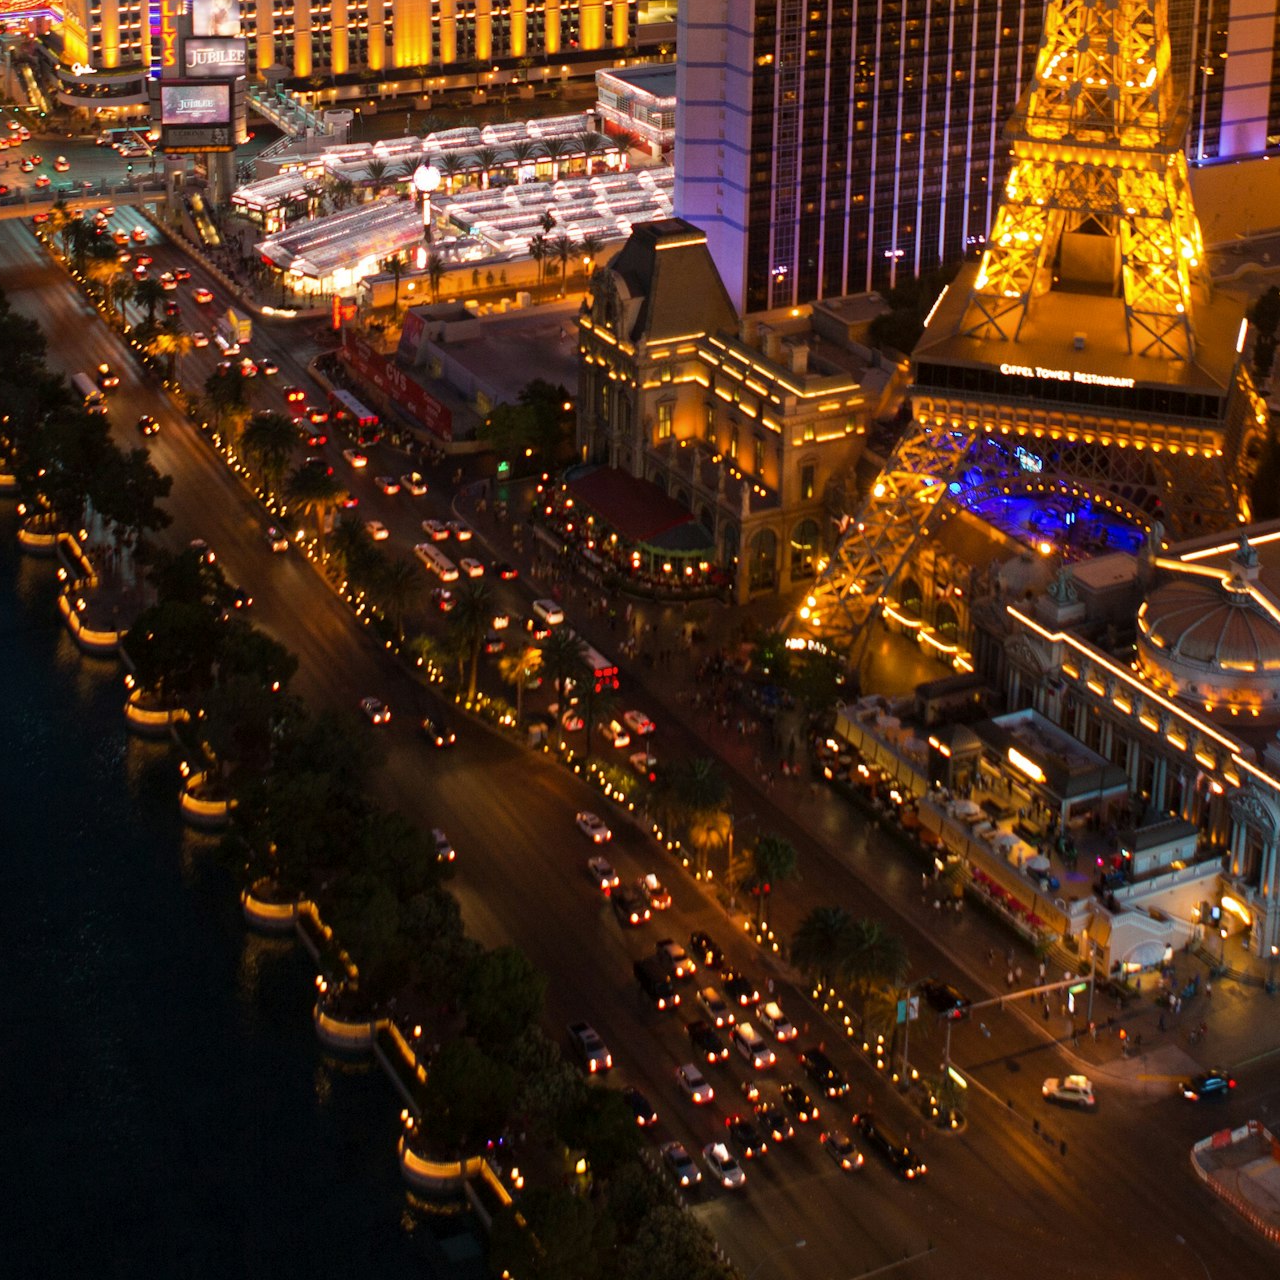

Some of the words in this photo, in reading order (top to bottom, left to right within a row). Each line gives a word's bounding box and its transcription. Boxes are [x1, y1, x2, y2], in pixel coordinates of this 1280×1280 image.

[187, 49, 245, 68] JUBILEE
[177, 99, 214, 111] JUBILEE
[386, 363, 407, 391] CVS
[1000, 363, 1034, 377] EIFFEL
[1035, 367, 1071, 381] TOWER
[1073, 372, 1136, 388] RESTAURANT
